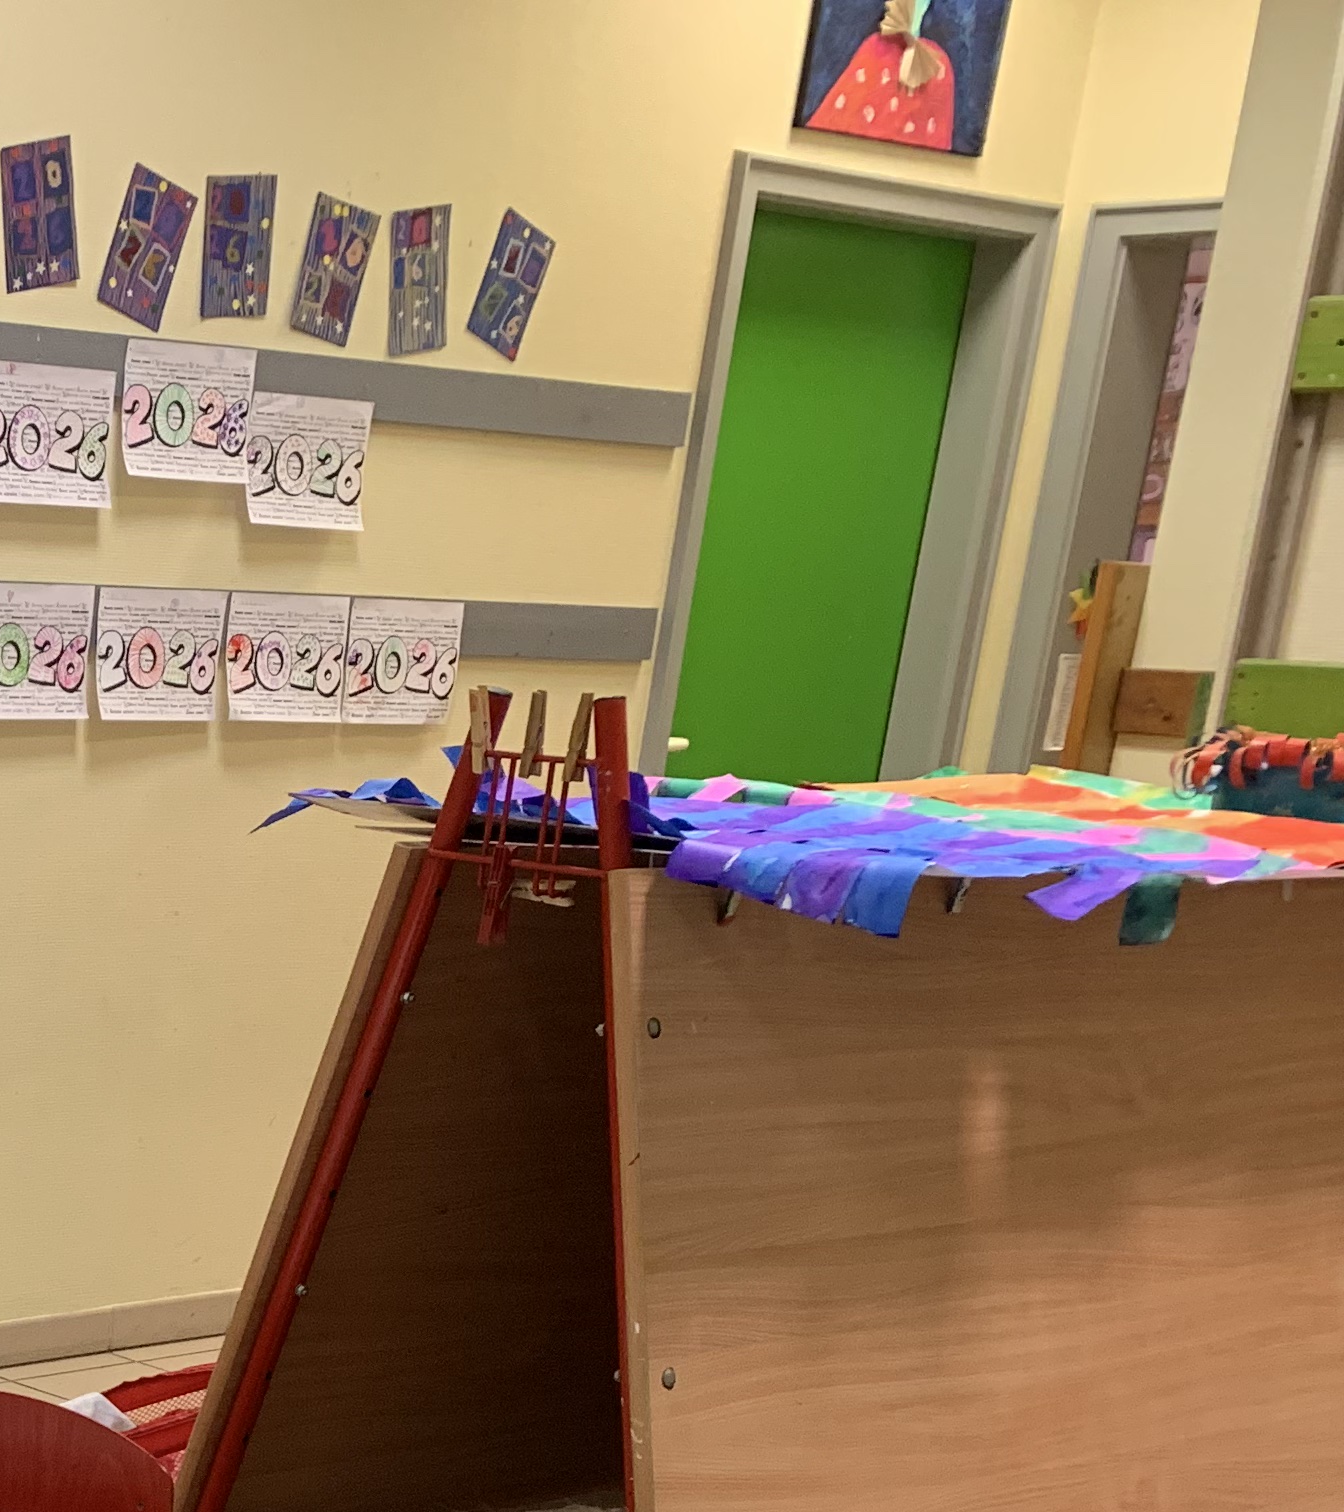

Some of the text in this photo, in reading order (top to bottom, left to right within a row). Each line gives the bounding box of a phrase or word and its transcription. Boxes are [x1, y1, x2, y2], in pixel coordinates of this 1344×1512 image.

[123, 383, 249, 457] 2026
[247, 434, 364, 506] 2026
[98, 626, 219, 695] 2026
[227, 631, 344, 697] 2026
[348, 635, 457, 699] 2026
